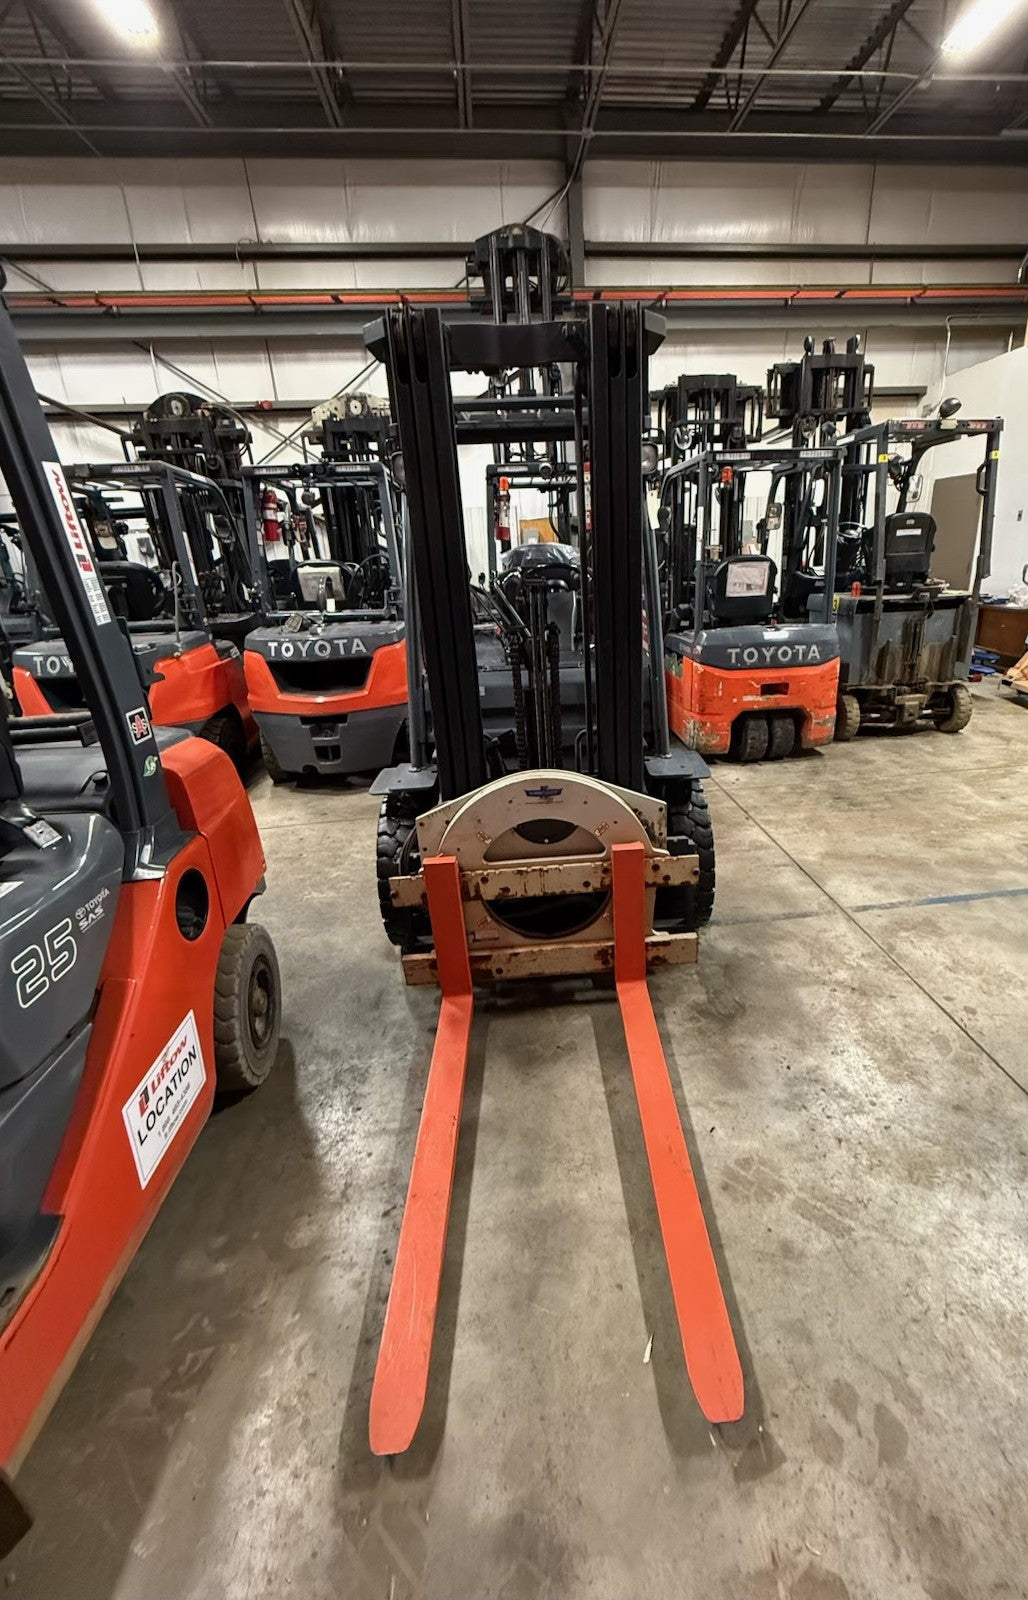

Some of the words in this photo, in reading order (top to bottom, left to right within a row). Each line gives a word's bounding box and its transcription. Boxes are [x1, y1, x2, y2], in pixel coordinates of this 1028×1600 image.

[267, 638, 368, 658] TOYOTA
[727, 644, 820, 664] TOYOTA
[33, 656, 75, 673] TOY
[84, 887, 110, 911] TOYOTA
[79, 905, 104, 930] SAS
[11, 917, 77, 1009] 25
[137, 1046, 197, 1146] LOCATION
